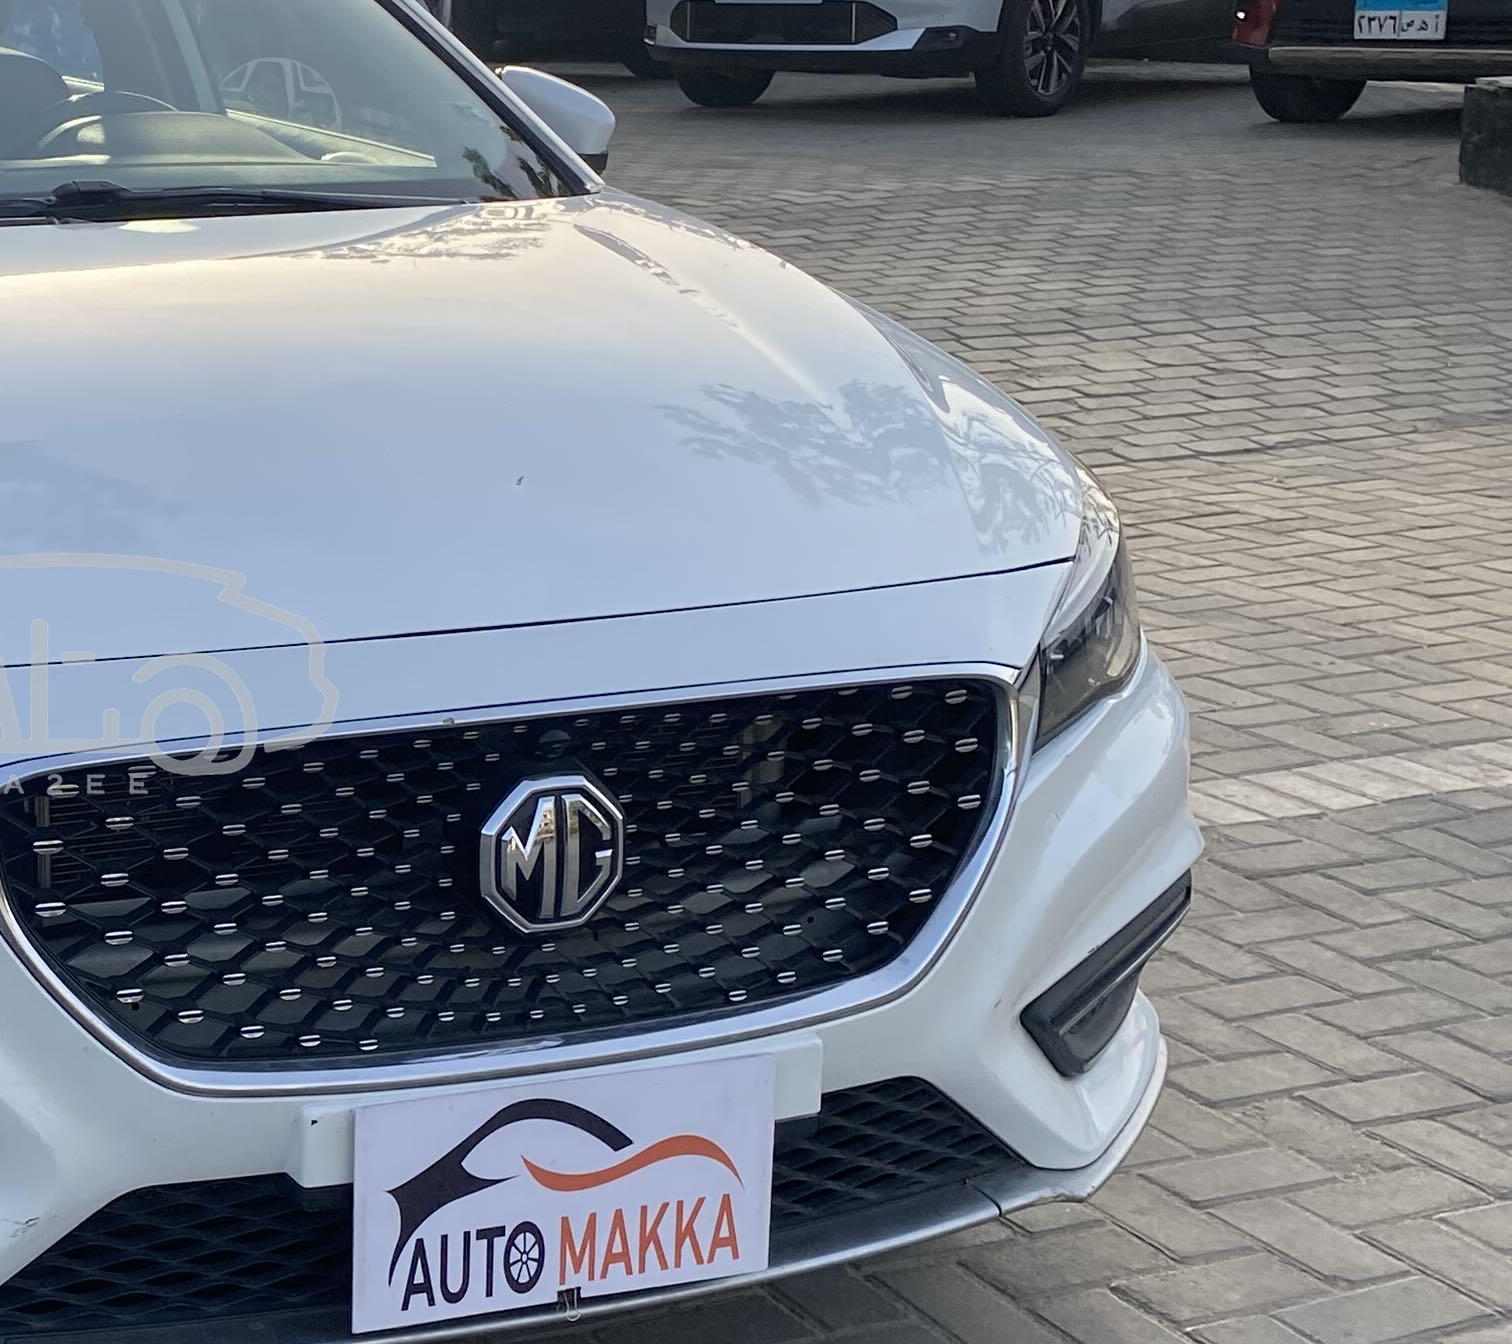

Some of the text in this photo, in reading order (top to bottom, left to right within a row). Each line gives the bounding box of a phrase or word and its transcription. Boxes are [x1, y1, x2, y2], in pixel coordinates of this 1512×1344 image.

[500, 793, 613, 919] MG
[401, 1192, 740, 1311] AUTO MAKKA
